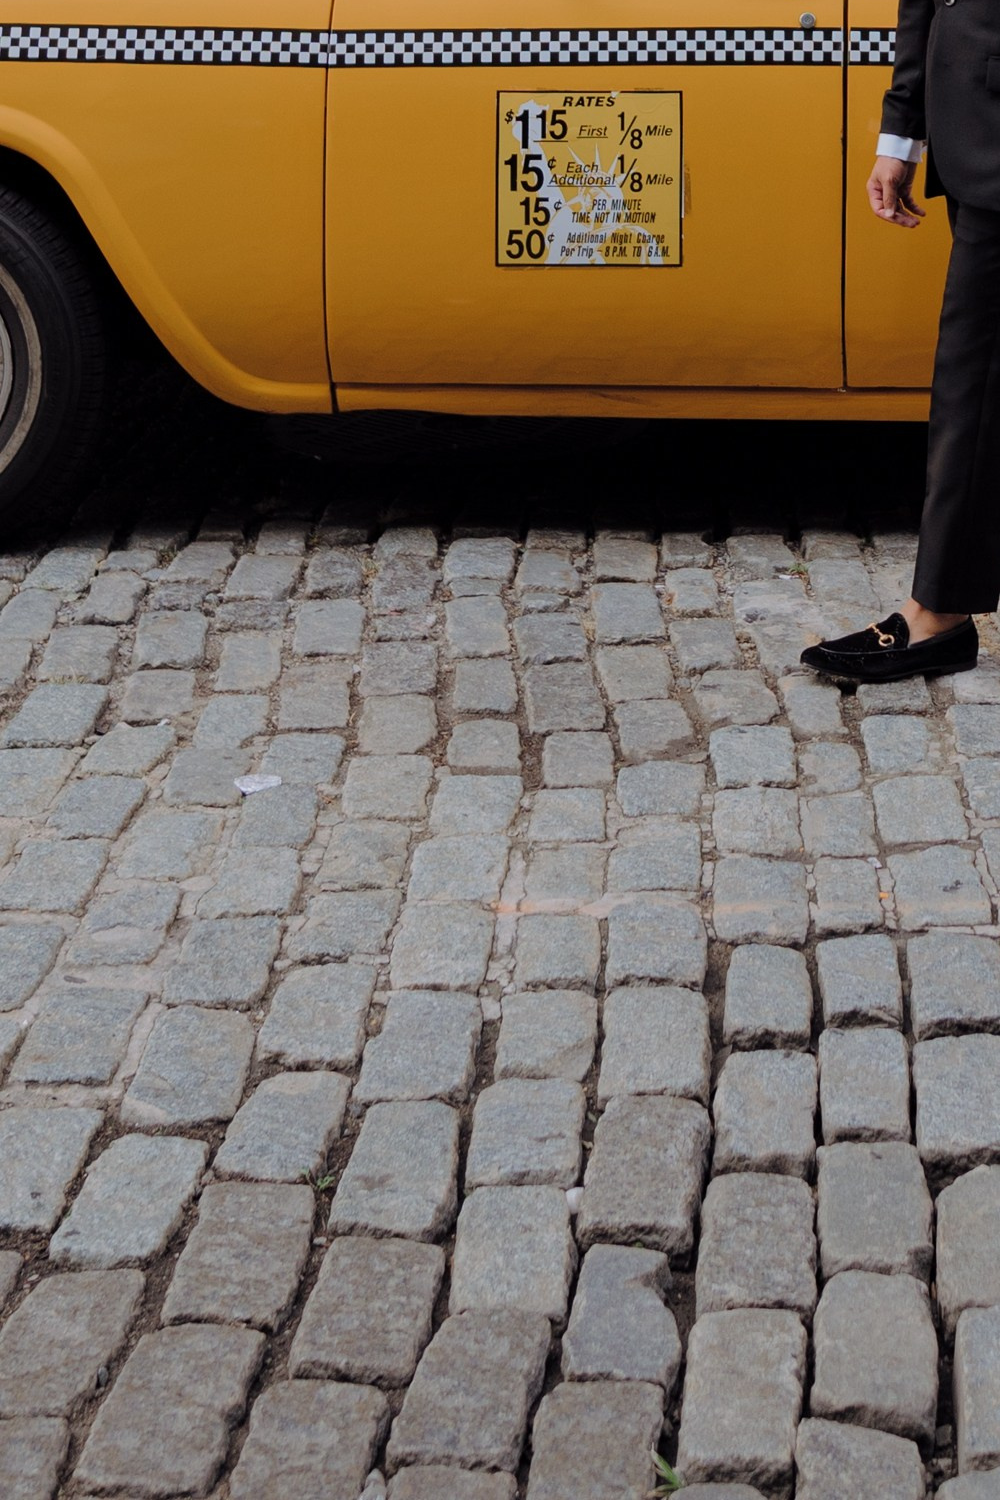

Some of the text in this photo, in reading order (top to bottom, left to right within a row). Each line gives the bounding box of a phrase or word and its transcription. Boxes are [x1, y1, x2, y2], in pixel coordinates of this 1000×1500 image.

[562, 96, 617, 107] RATES
[578, 124, 608, 137] First
[645, 125, 673, 137] Mile
[549, 173, 616, 186] Additional
[566, 161, 599, 173] Each
[645, 174, 674, 186] Mile
[591, 199, 607, 211] PER
[611, 199, 642, 211] MINUTE
[571, 211, 656, 224] TIME NOT IN MOTION
[566, 232, 607, 244] Additional
[610, 232, 632, 245] Night
[636, 232, 665, 245] Charge
[560, 246, 575, 257] Per
[577, 246, 594, 258] Trip
[632, 246, 642, 257] TO
